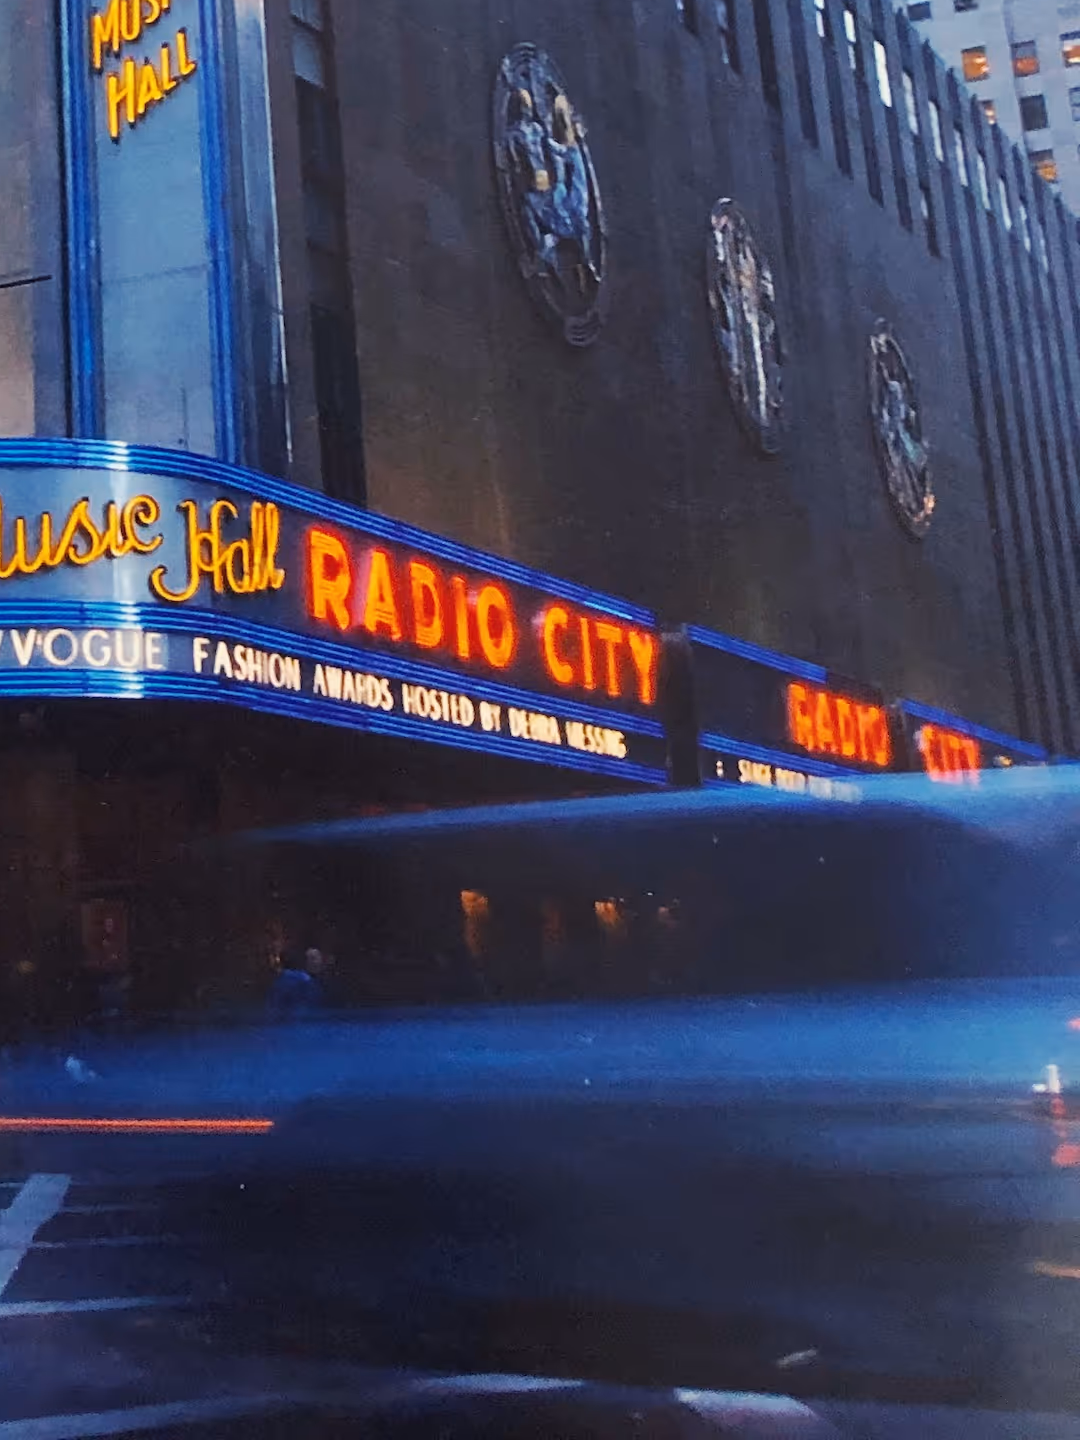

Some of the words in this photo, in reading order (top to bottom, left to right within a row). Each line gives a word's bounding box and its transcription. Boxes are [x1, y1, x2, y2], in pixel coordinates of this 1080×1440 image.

[105, 28, 197, 144] HALL
[150, 498, 286, 602] Hall
[306, 527, 517, 669] RADIO
[541, 603, 658, 705] CITY
[192, 637, 301, 692] FASHION
[312, 663, 395, 712] AWARDS
[401, 683, 475, 727] HOSTED
